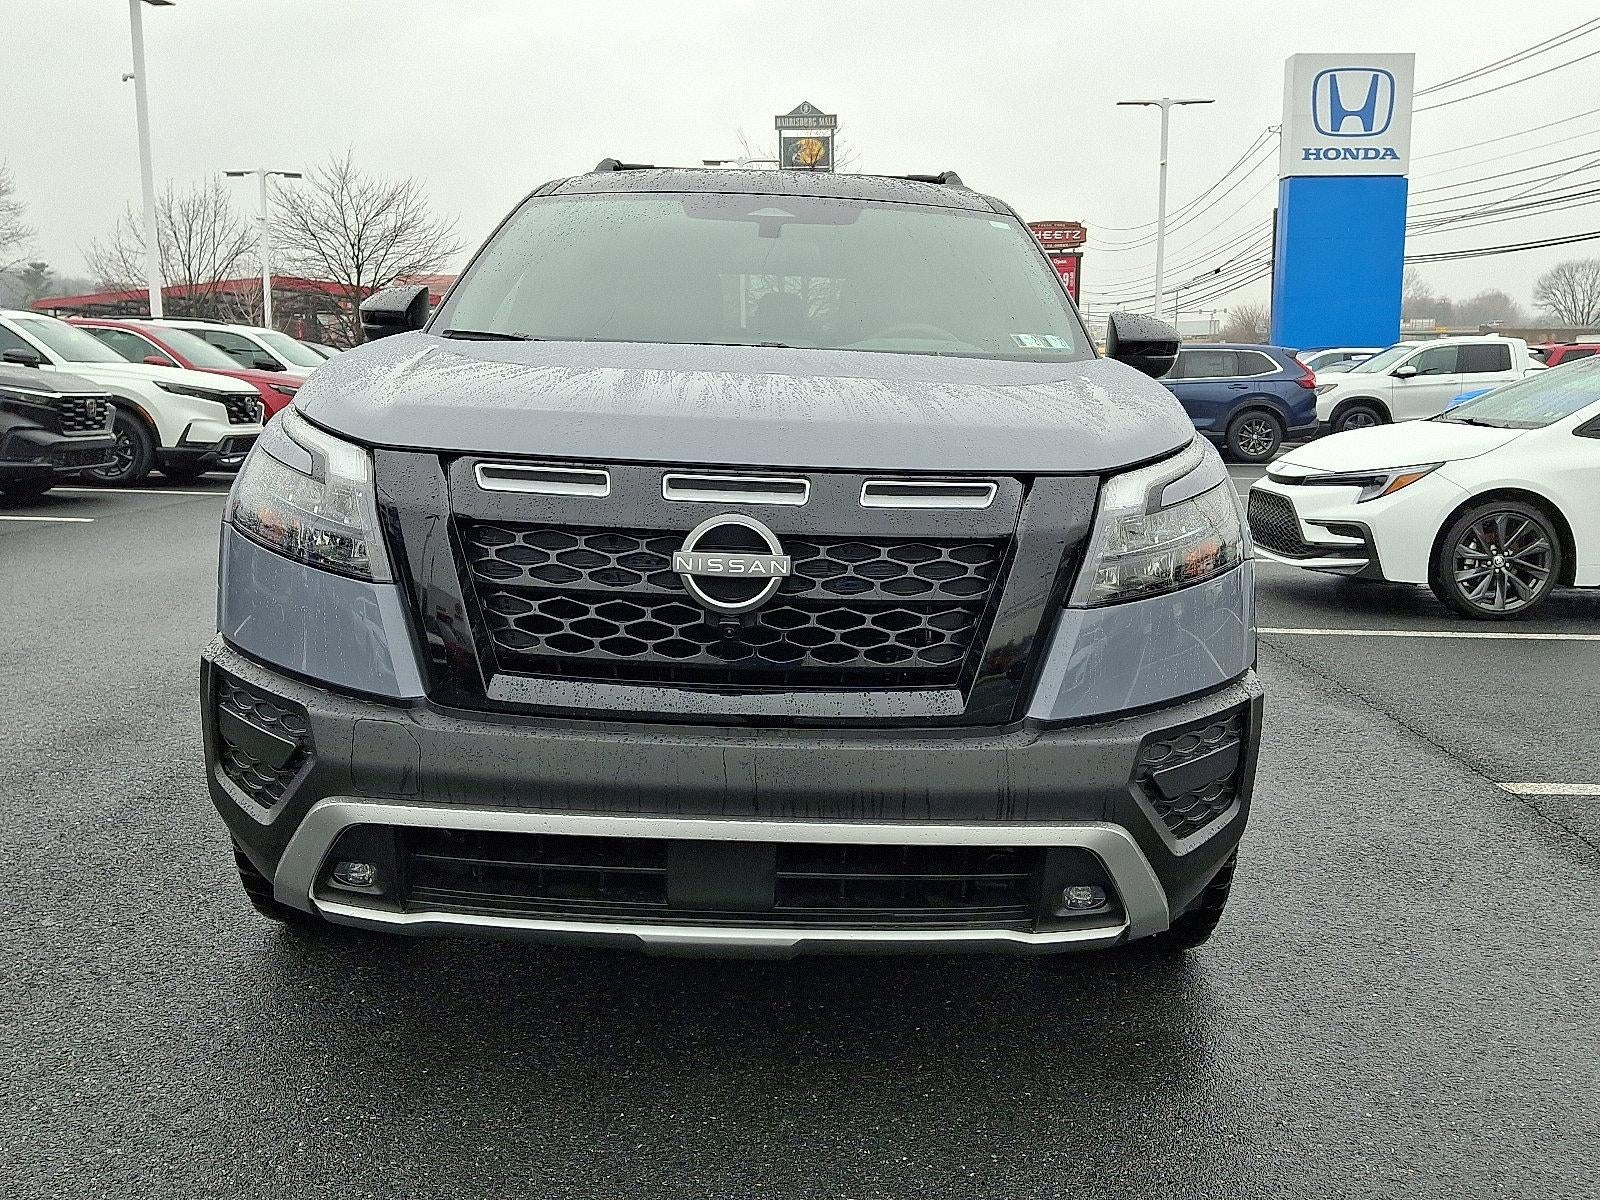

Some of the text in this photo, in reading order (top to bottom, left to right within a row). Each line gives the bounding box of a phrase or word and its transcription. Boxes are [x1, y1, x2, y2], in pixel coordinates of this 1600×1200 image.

[819, 116, 836, 126] MALL
[1301, 147, 1401, 161] HONDA
[1031, 230, 1081, 240] HEETZ
[676, 556, 787, 574] NISSAN
